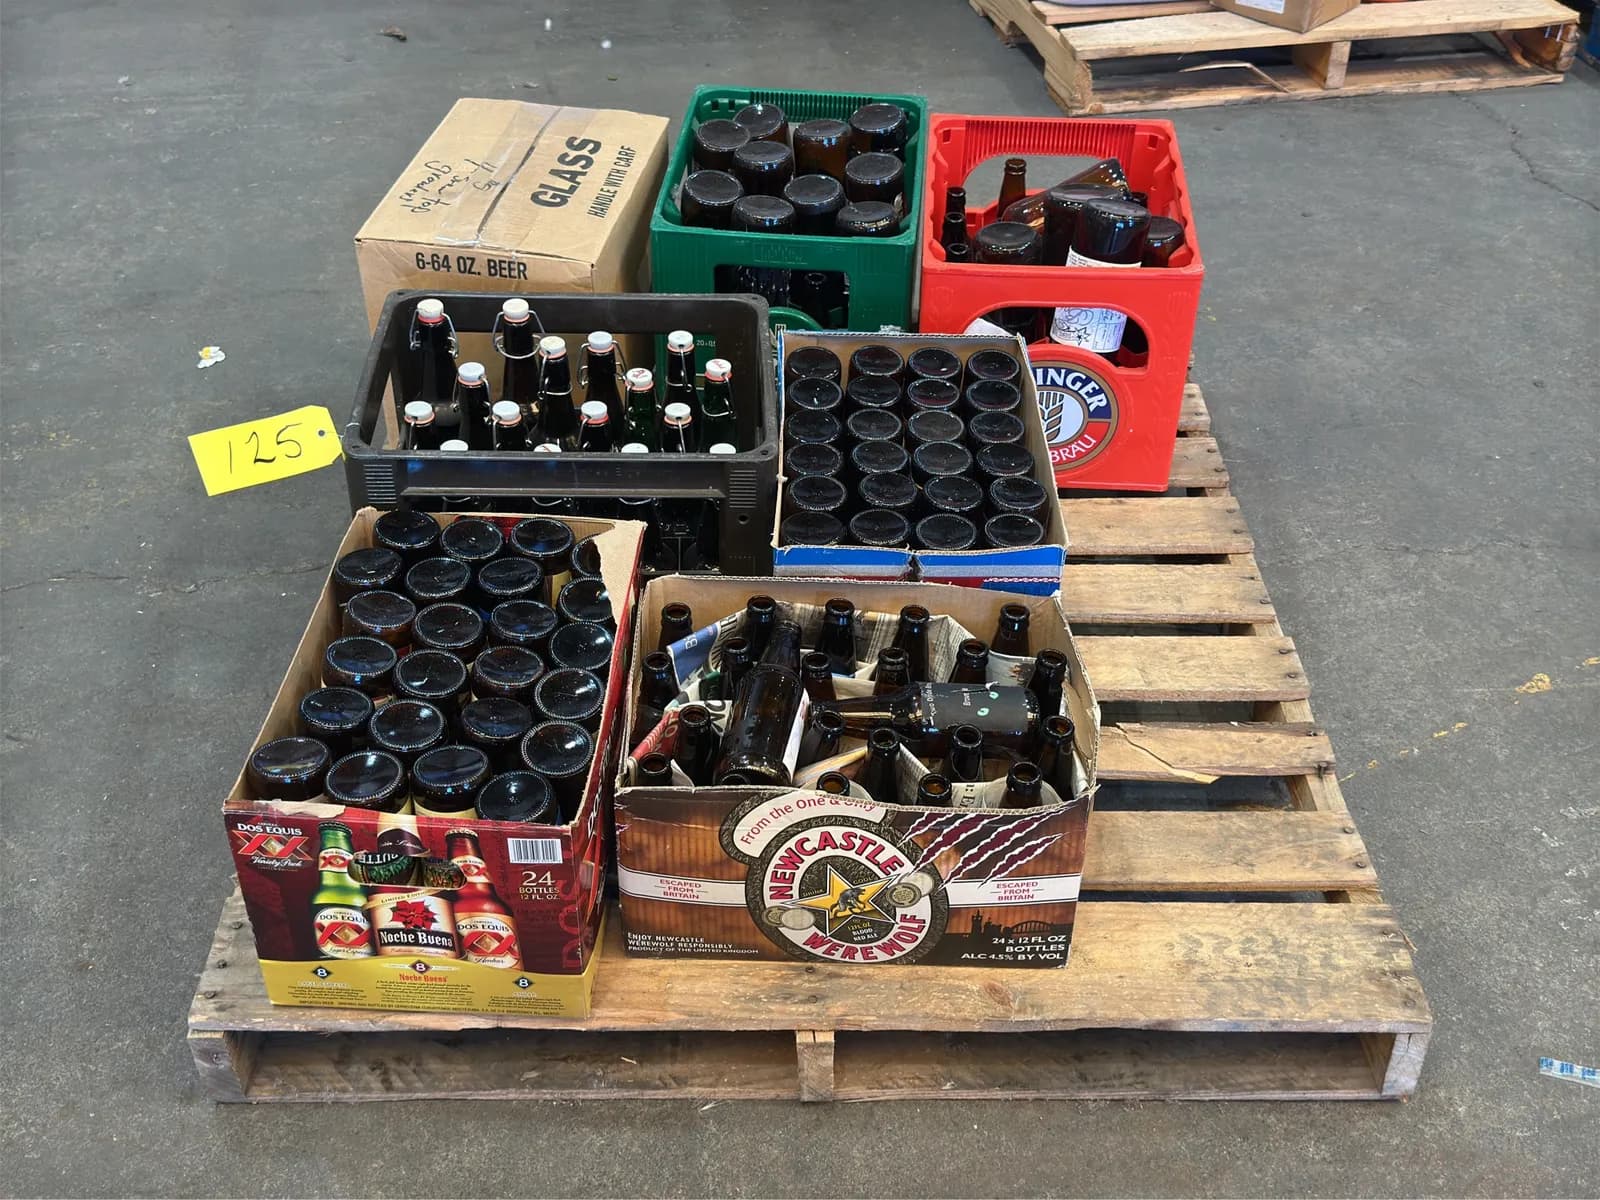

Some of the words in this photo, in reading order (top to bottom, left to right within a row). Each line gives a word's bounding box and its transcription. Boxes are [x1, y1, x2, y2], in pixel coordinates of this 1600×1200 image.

[530, 136, 602, 208] GLASS
[586, 187, 618, 219] HANDLE
[603, 168, 628, 188] WITH
[415, 252, 452, 273] 6-64
[456, 255, 481, 276] OZ.
[487, 258, 528, 280] BEER
[229, 422, 303, 475] 125
[740, 817, 772, 845] From
[769, 805, 794, 820] the
[796, 797, 825, 809] One
[237, 823, 263, 833] DOS
[266, 826, 302, 836] EQUIS
[251, 856, 281, 868] Variety
[280, 859, 303, 867] Pack
[769, 831, 905, 900] NEWCASTLE
[522, 871, 556, 886] 24
[660, 879, 702, 888] ESCAPED
[996, 881, 1039, 889] ESCAPED
[663, 891, 699, 899] BRITAIN
[341, 914, 369, 927] EQUI
[481, 924, 510, 932] EQUIS
[380, 931, 415, 944] Noche
[417, 932, 453, 948] Buena
[628, 932, 652, 942] ENJOY
[628, 939, 674, 947] WEREWOLF
[803, 914, 927, 961] WEREWOLF
[1018, 936, 1029, 944] 12
[1005, 944, 1065, 953] BOTTLES
[317, 968, 328, 977] 8
[416, 962, 425, 971] 8
[519, 978, 529, 987] 8
